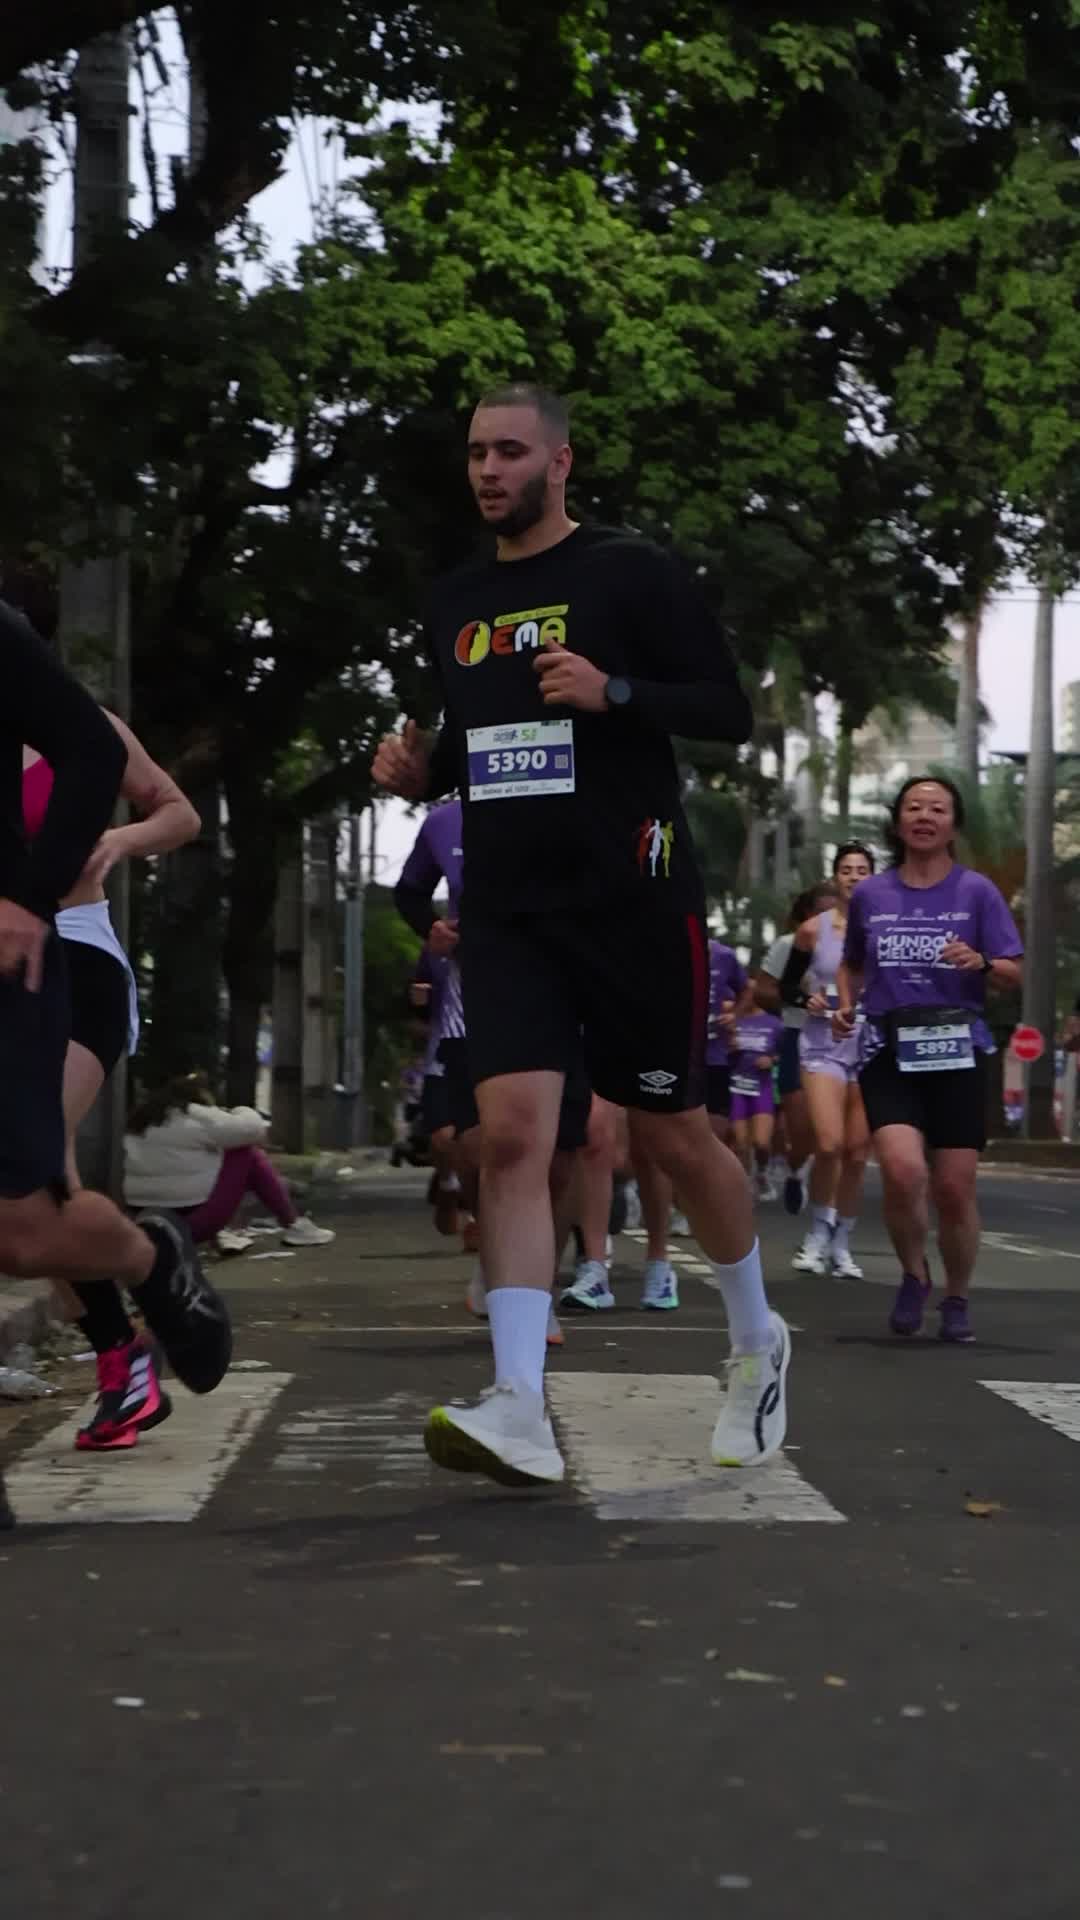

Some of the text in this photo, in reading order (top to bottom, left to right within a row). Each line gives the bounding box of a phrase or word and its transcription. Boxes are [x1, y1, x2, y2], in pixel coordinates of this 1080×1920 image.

[491, 617, 567, 655] EMA
[487, 749, 547, 774] 5390
[878, 935, 946, 949] MUNDO
[915, 1040, 959, 1055] 5892
